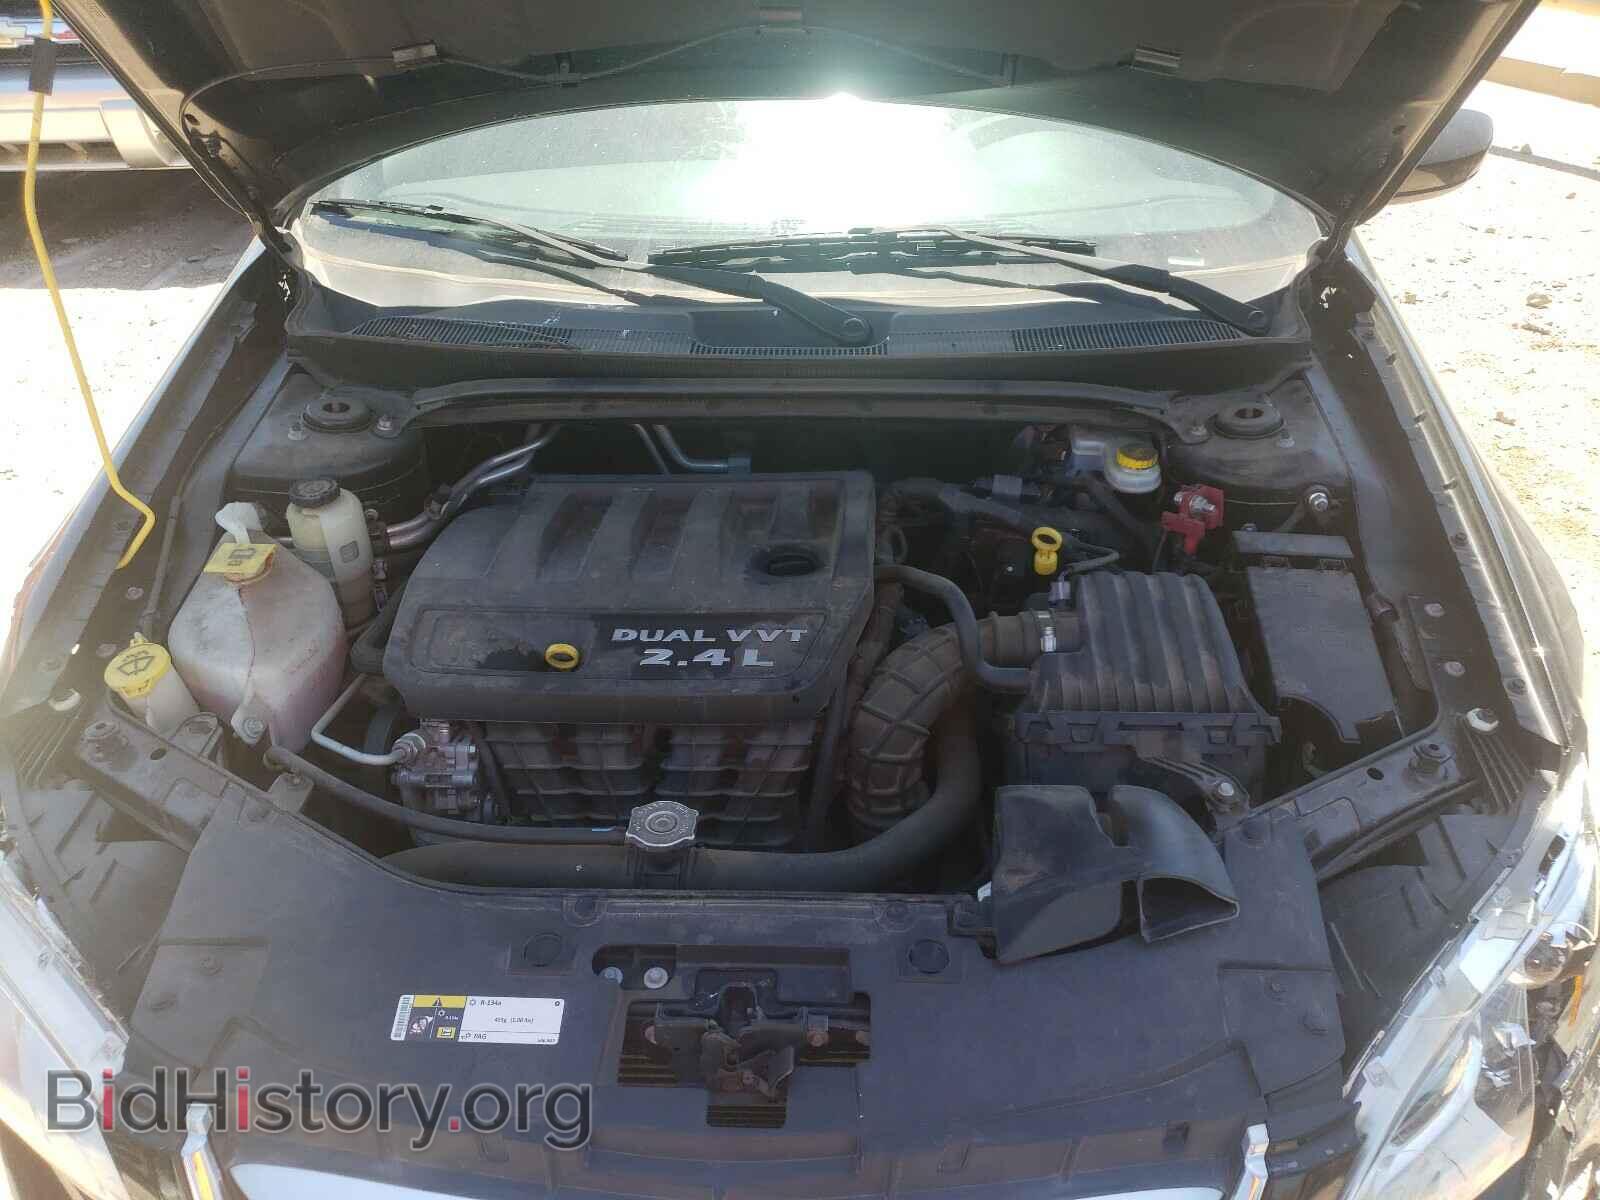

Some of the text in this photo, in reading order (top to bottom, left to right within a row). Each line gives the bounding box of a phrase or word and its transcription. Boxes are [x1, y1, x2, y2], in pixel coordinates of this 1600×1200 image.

[611, 628, 808, 642] DUAL VVT
[480, 999, 502, 1007] R-134a
